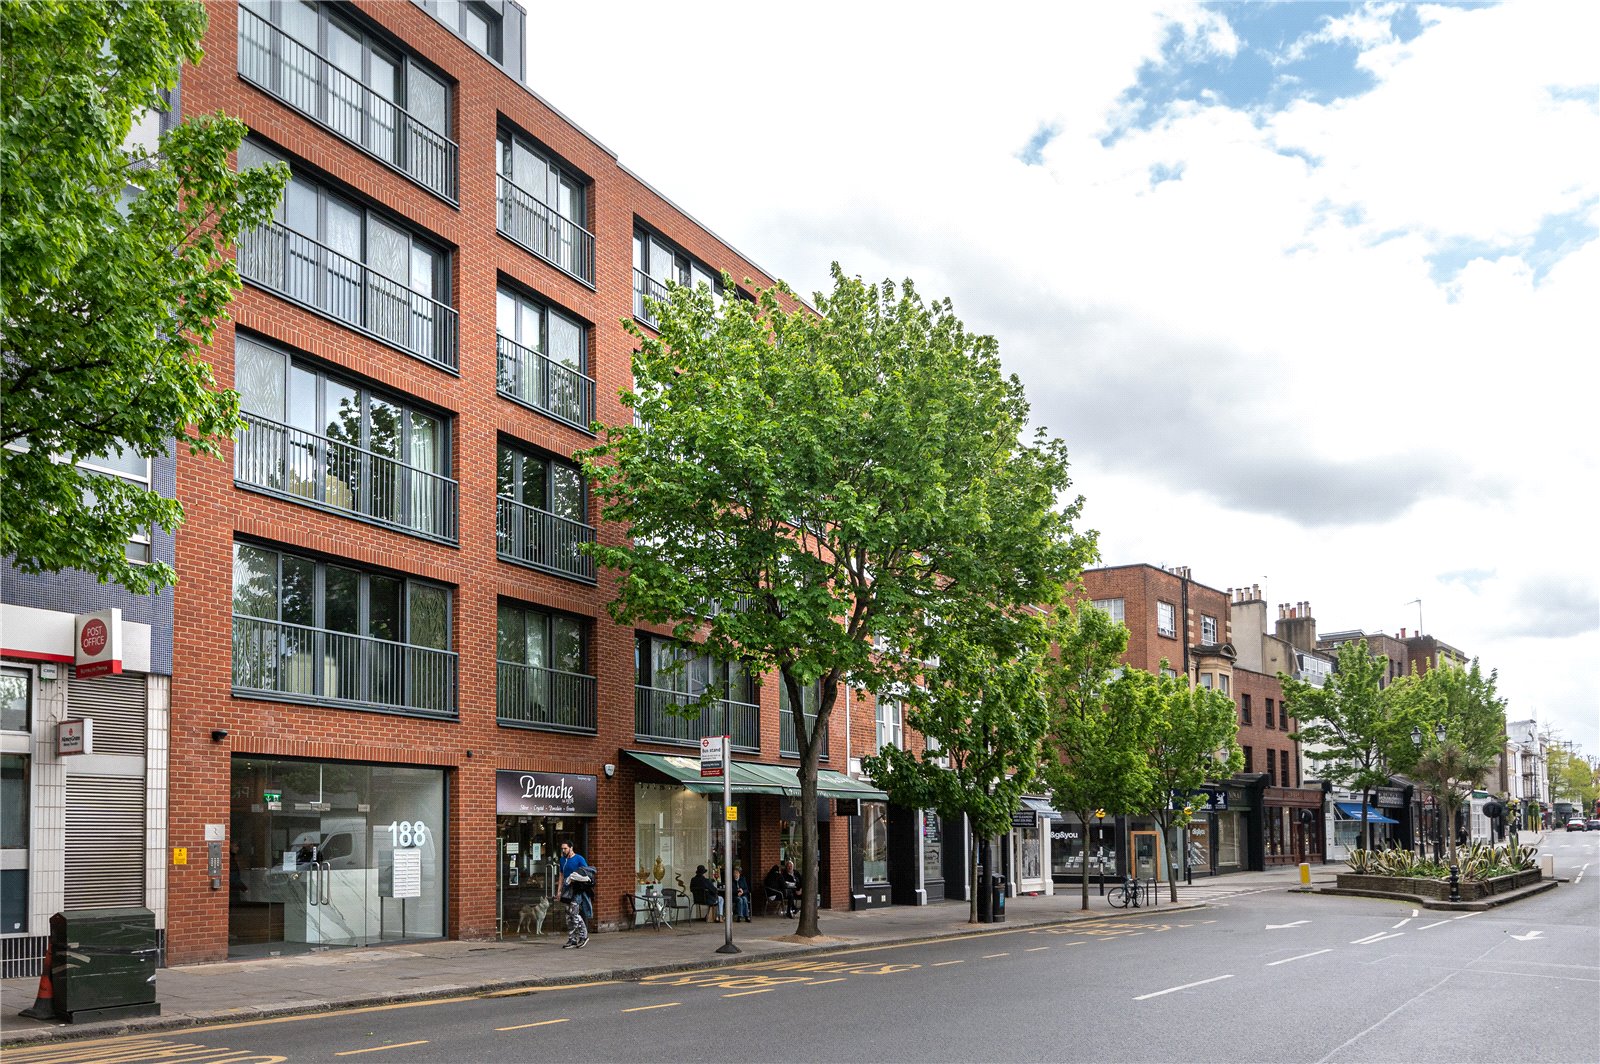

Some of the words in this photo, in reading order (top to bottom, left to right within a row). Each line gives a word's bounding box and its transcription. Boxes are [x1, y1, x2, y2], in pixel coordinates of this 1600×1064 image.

[87, 626, 102, 636] POST
[83, 636, 105, 648] OFFICE
[520, 775, 574, 799] Panache
[387, 820, 426, 847] 188
[1050, 830, 1079, 840] &g&you
